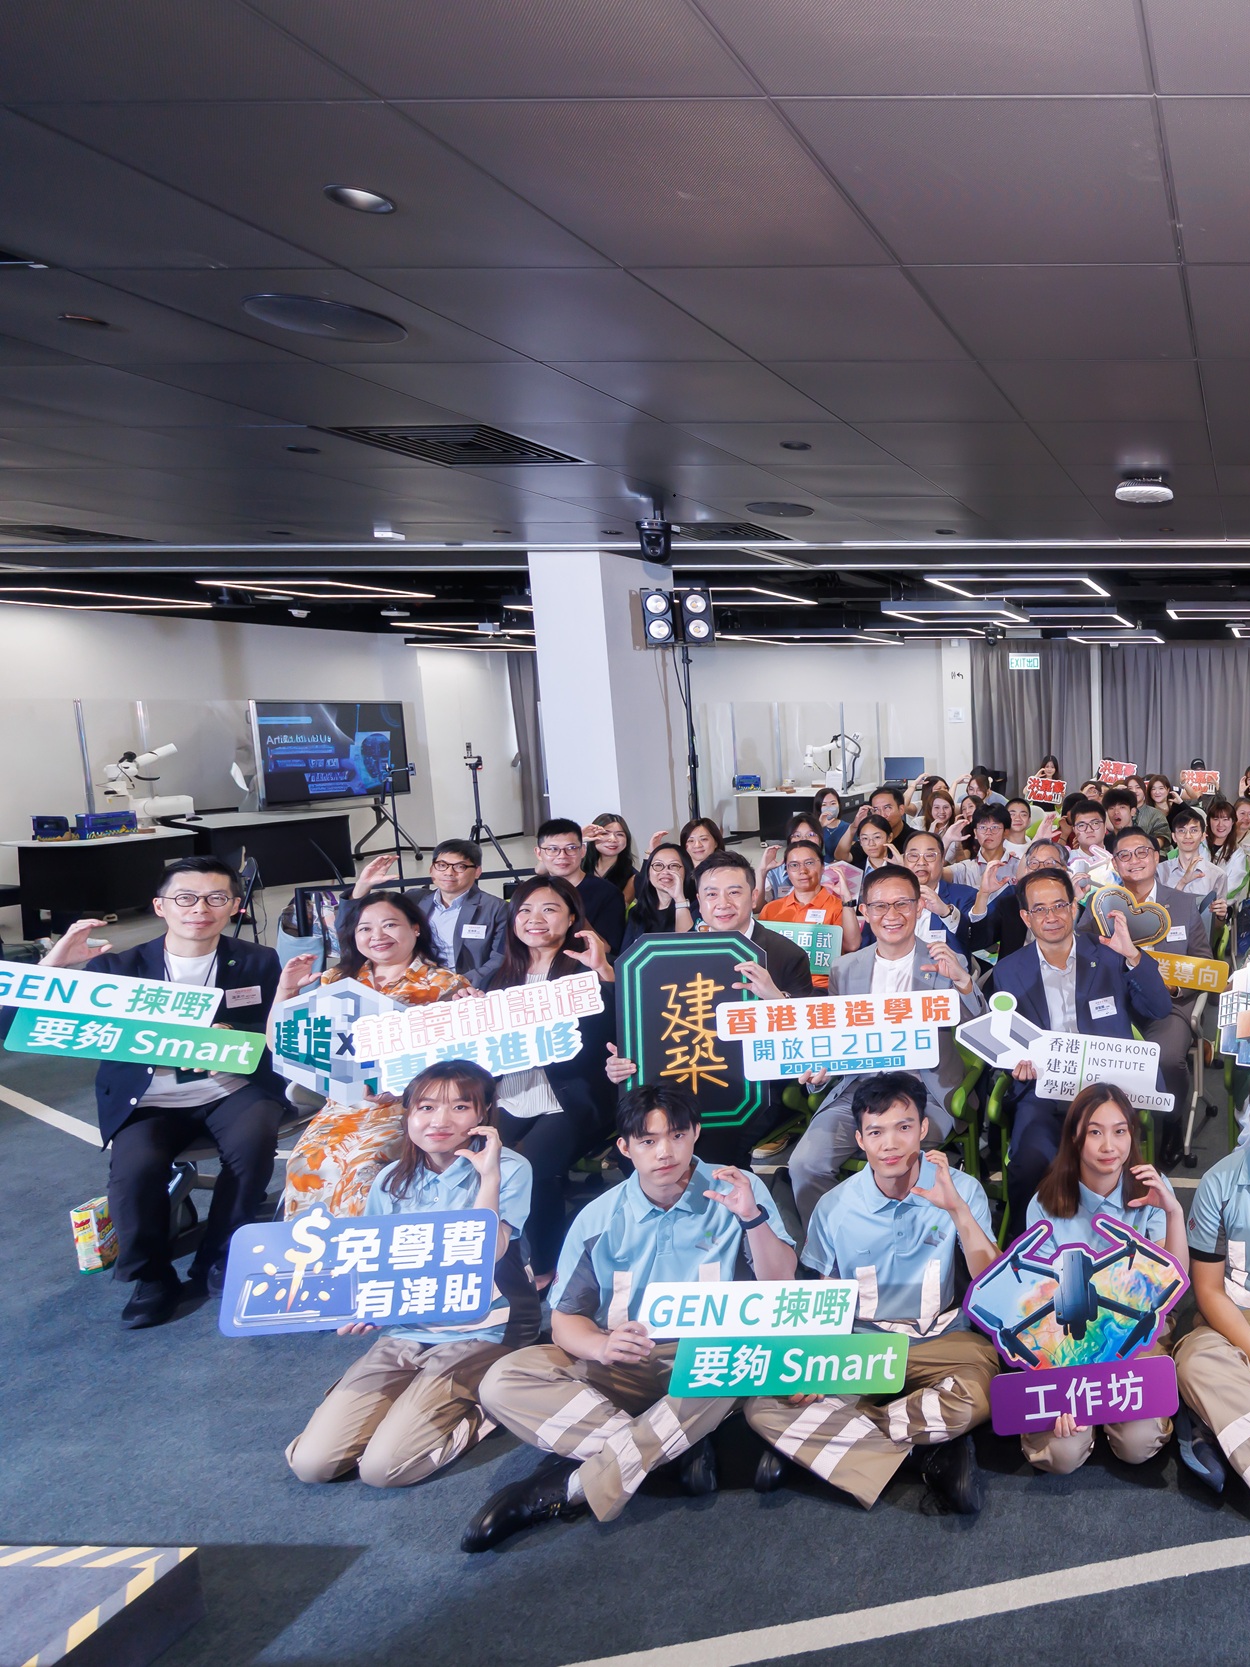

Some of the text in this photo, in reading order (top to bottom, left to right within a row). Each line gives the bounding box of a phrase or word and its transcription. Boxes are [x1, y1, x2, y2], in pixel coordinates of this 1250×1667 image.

[1010, 658, 1026, 668] EXIT
[1026, 658, 1039, 668] 出口
[1157, 957, 1219, 988] 業導向
[0, 971, 215, 1021] GEN C 揀嘢
[356, 975, 600, 1058] 兼讀制課程
[726, 995, 952, 1035] 香港建造學院
[27, 1016, 253, 1065] 要夠 Smart
[274, 1009, 332, 1072] 建造
[752, 1029, 932, 1062] 開放日2026
[1049, 1037, 1081, 1054] 香港
[1090, 1041, 1157, 1057] HONG KONG
[784, 1056, 902, 1074] 202605.29-30
[1046, 1058, 1078, 1076] 建造
[1086, 1073, 1101, 1082] OF
[1087, 1057, 1146, 1072] INSTITUTE
[1043, 1079, 1076, 1097] 學院
[331, 1220, 486, 1278] 免學費
[355, 1272, 483, 1319] 有津貼
[648, 1287, 852, 1328] GEN C 揀嘢
[688, 1344, 898, 1389] 要夠 Smart
[1024, 1370, 1145, 1421] 工作坊
